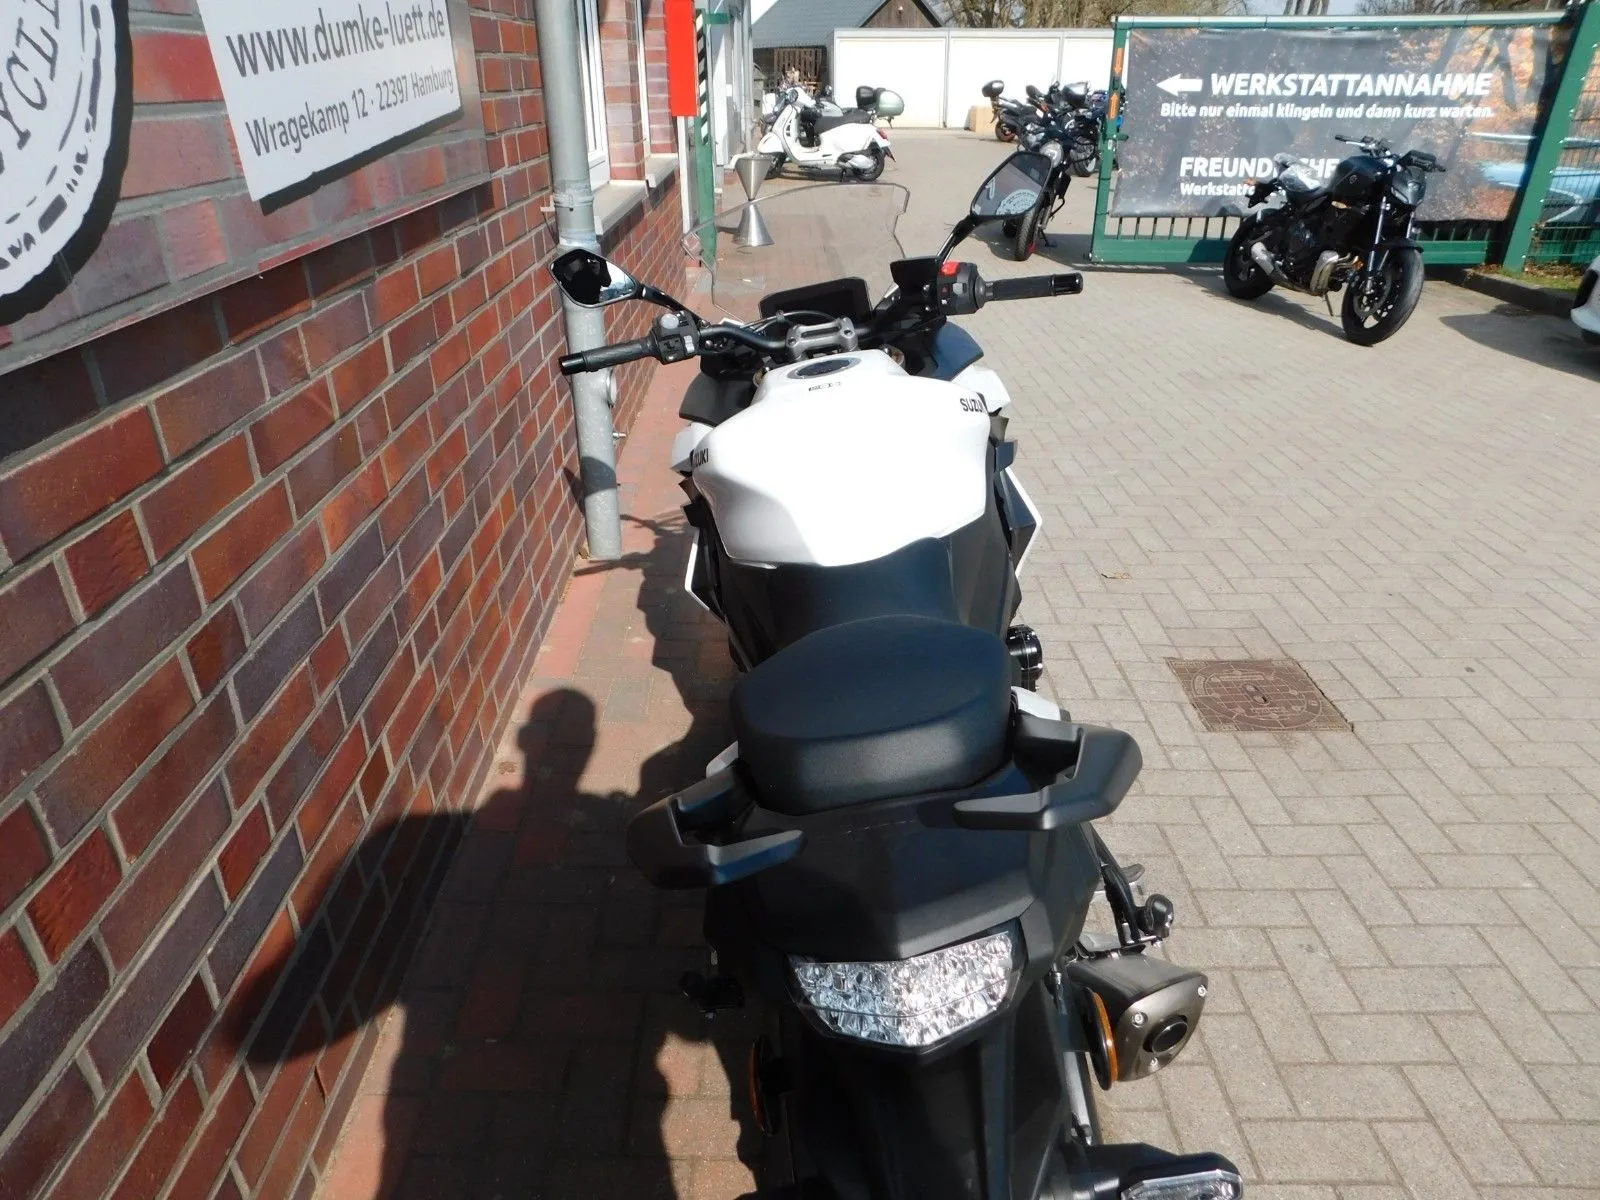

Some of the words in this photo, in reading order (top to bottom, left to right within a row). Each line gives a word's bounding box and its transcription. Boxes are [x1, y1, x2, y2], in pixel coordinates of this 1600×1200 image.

[225, 0, 446, 78] www.dumke-luett.de
[1210, 72, 1493, 97] WERKSTATTANNAHME
[245, 101, 350, 157] Wragekamp
[351, 87, 369, 120] 12
[375, 75, 410, 111] 22397
[410, 67, 454, 99] Hamburg
[1160, 101, 1197, 118] Bitte
[1199, 104, 1225, 118] nur
[1226, 102, 1274, 118] einmal
[1276, 102, 1333, 121] klingeln
[1336, 103, 1365, 119] und
[1365, 103, 1401, 119] dann
[1404, 103, 1437, 119] kurz
